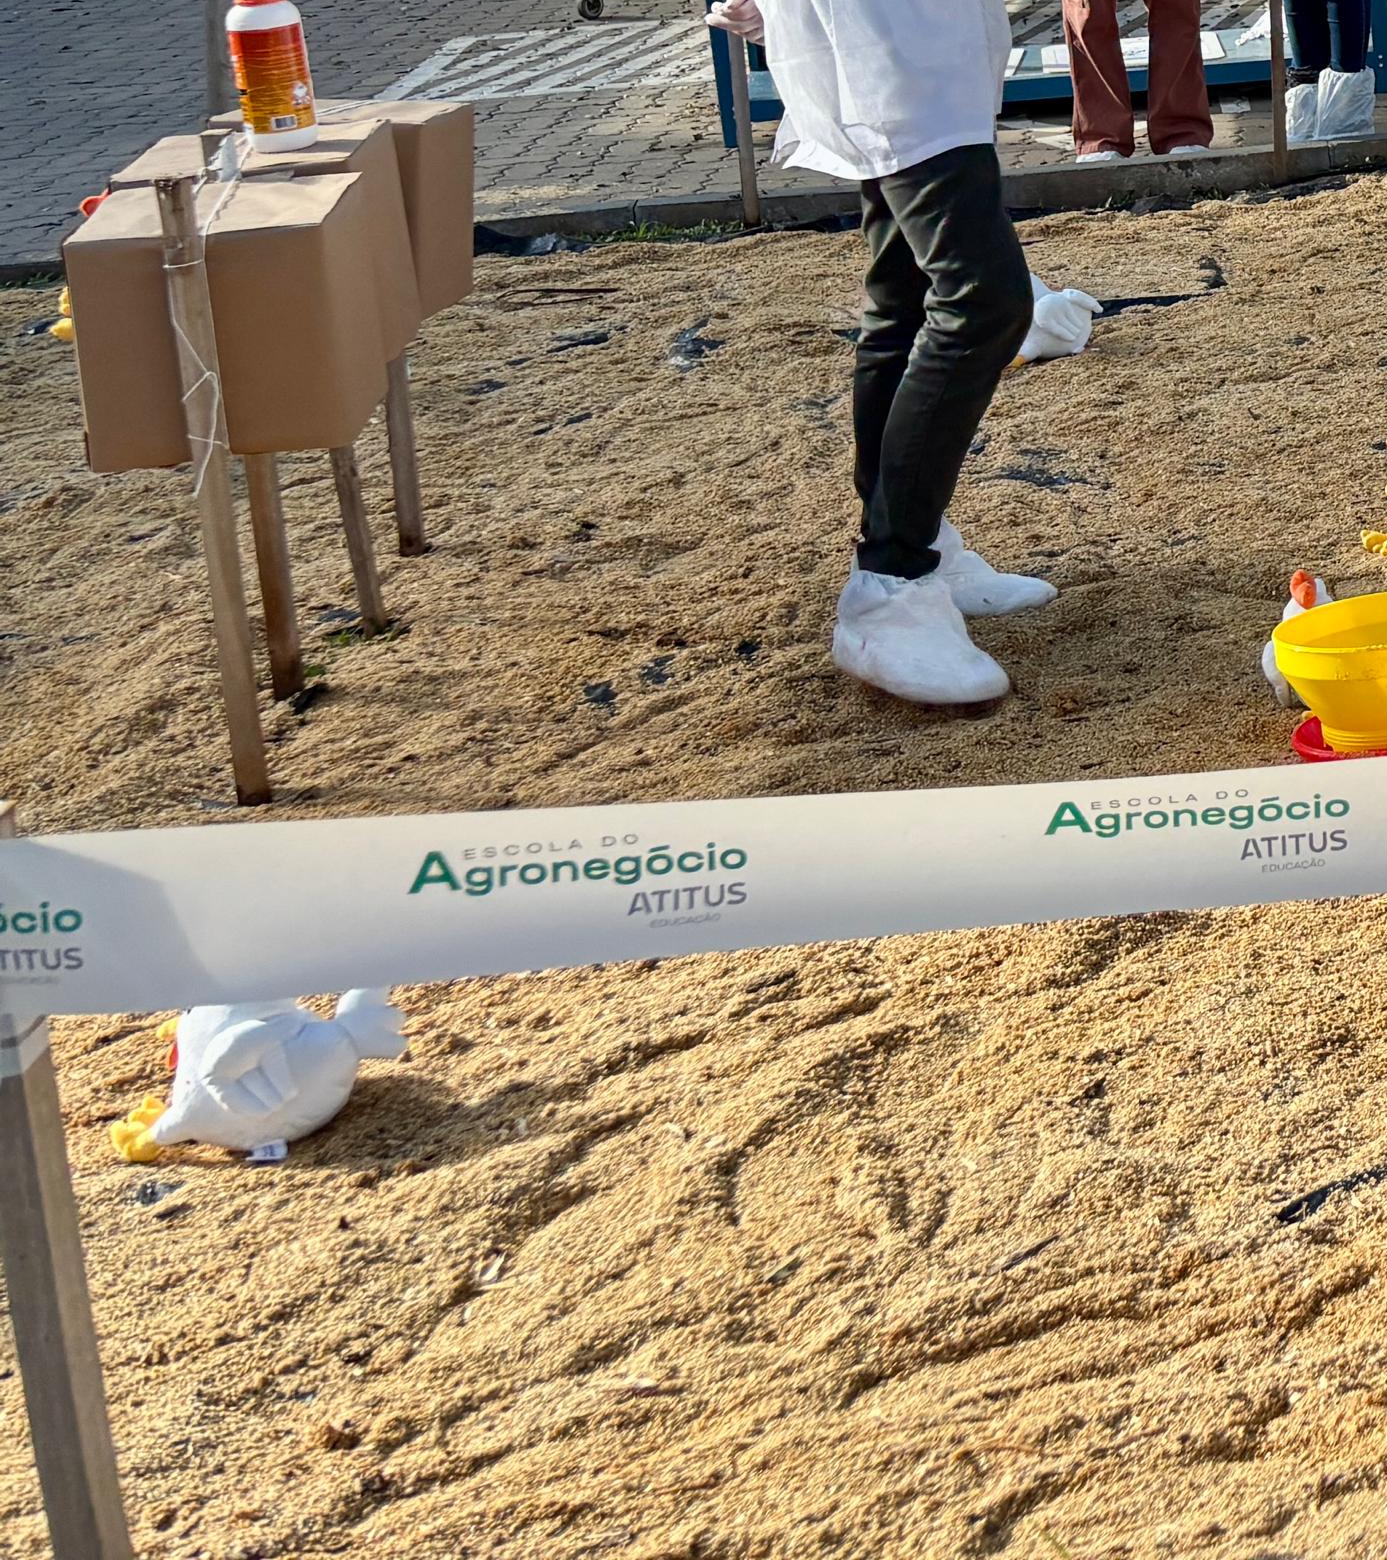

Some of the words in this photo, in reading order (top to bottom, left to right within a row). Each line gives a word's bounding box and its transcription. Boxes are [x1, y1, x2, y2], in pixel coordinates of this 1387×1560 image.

[1044, 793, 1350, 838] Agronegócio
[1091, 793, 1198, 810] ESCOLA
[1215, 789, 1249, 800] DO
[462, 838, 584, 861] ESCOLA
[601, 833, 639, 848] DO
[1240, 829, 1348, 861] ATITUS
[407, 842, 748, 897] Agronegócio
[1261, 858, 1326, 873] EDUCAÇÃO
[627, 881, 748, 916] ATITUS
